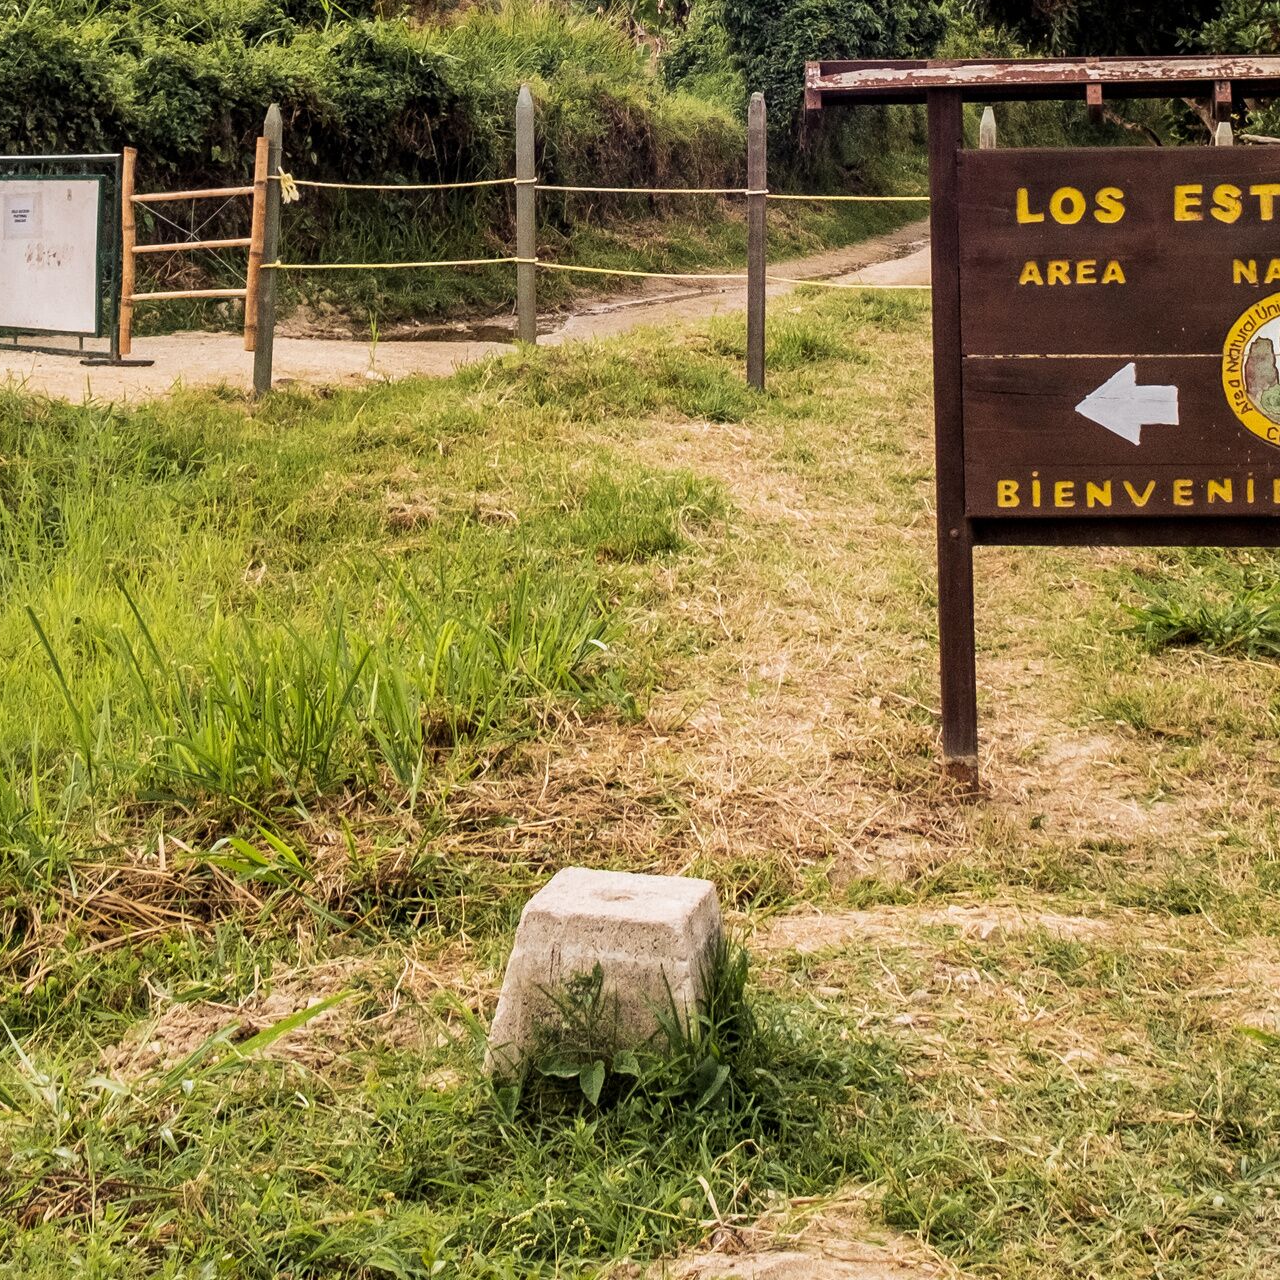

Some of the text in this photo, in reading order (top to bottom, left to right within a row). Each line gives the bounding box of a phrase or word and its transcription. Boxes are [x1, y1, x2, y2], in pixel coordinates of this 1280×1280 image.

[1015, 186, 1126, 225] LOS
[1018, 259, 1127, 286] AREA
[1225, 314, 1258, 373] Natural
[1227, 379, 1254, 415] Area
